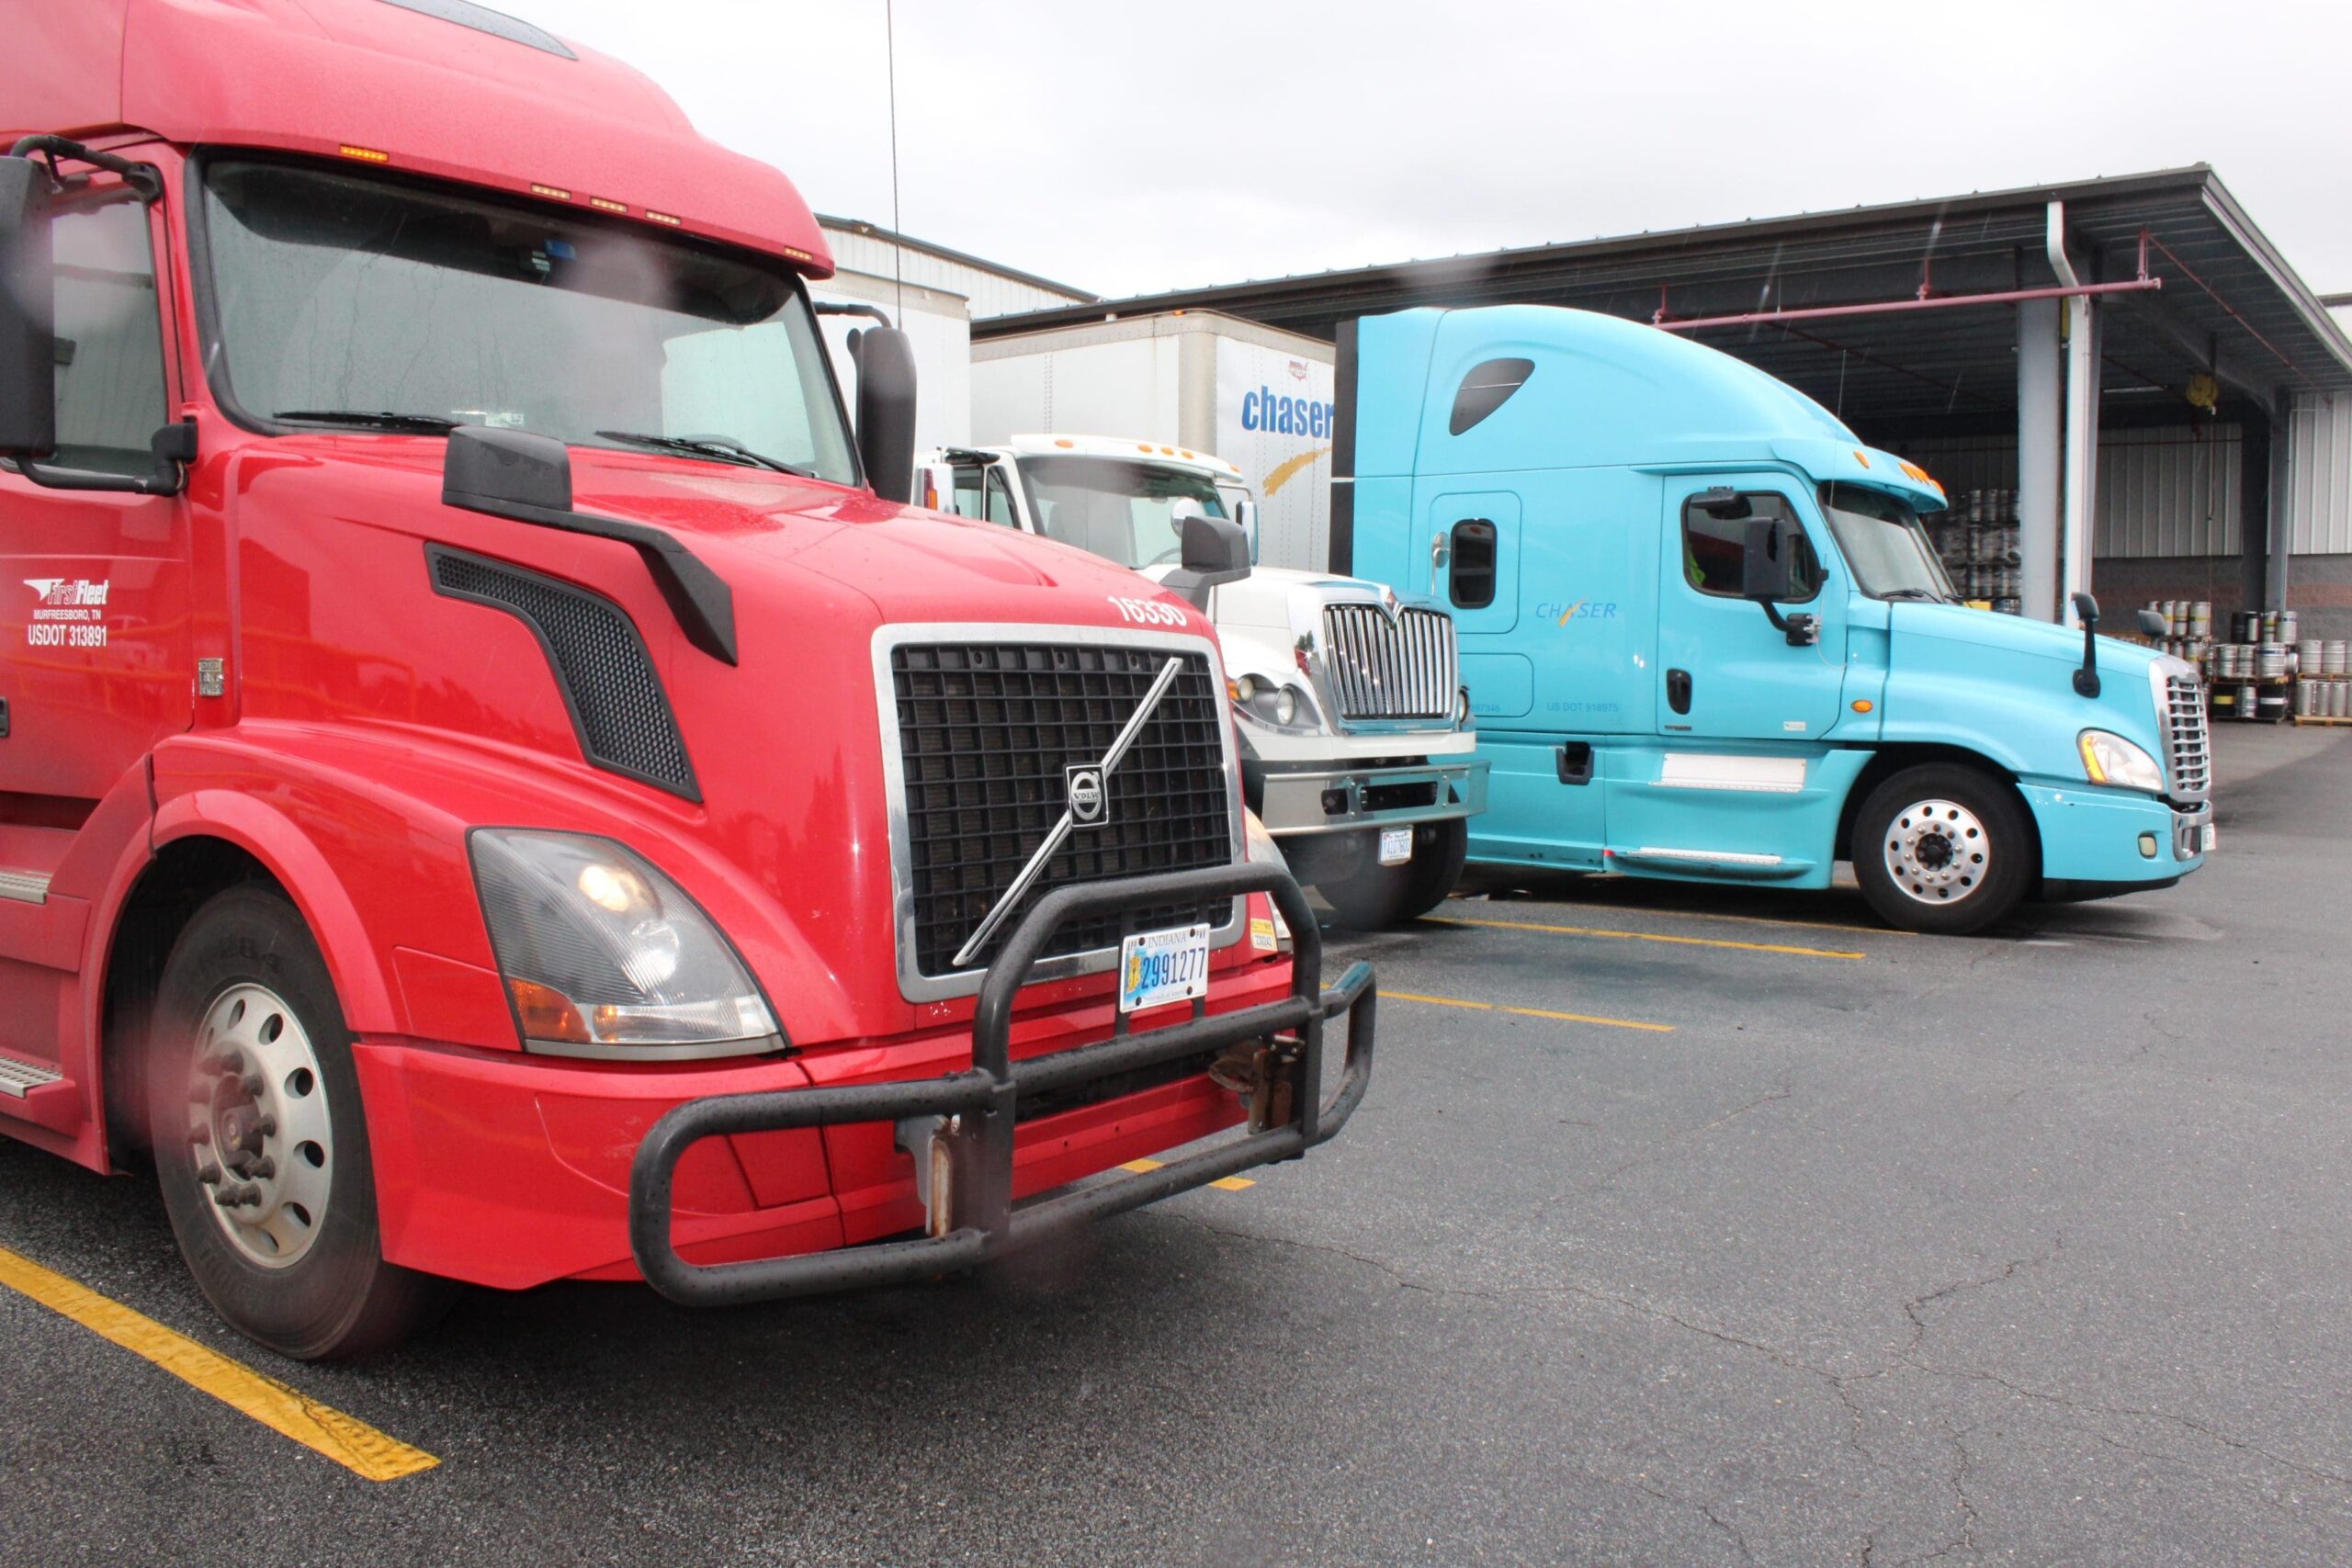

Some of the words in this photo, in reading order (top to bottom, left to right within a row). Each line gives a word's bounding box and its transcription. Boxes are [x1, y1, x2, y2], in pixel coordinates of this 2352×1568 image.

[1241, 384, 1336, 439] chaser
[33, 609, 90, 622] MURFREESBORO,
[91, 609, 102, 620] TN
[1107, 596, 1187, 626] 16330
[1535, 603, 1617, 618] CHASER
[28, 625, 67, 646] USDOT
[69, 625, 107, 647] 313891
[1547, 703, 1560, 712] US
[1563, 703, 1584, 712] DOT
[1073, 791, 1101, 800] VOLVO
[1148, 931, 1187, 949] INDIANA
[1140, 946, 1206, 990] 2991277
